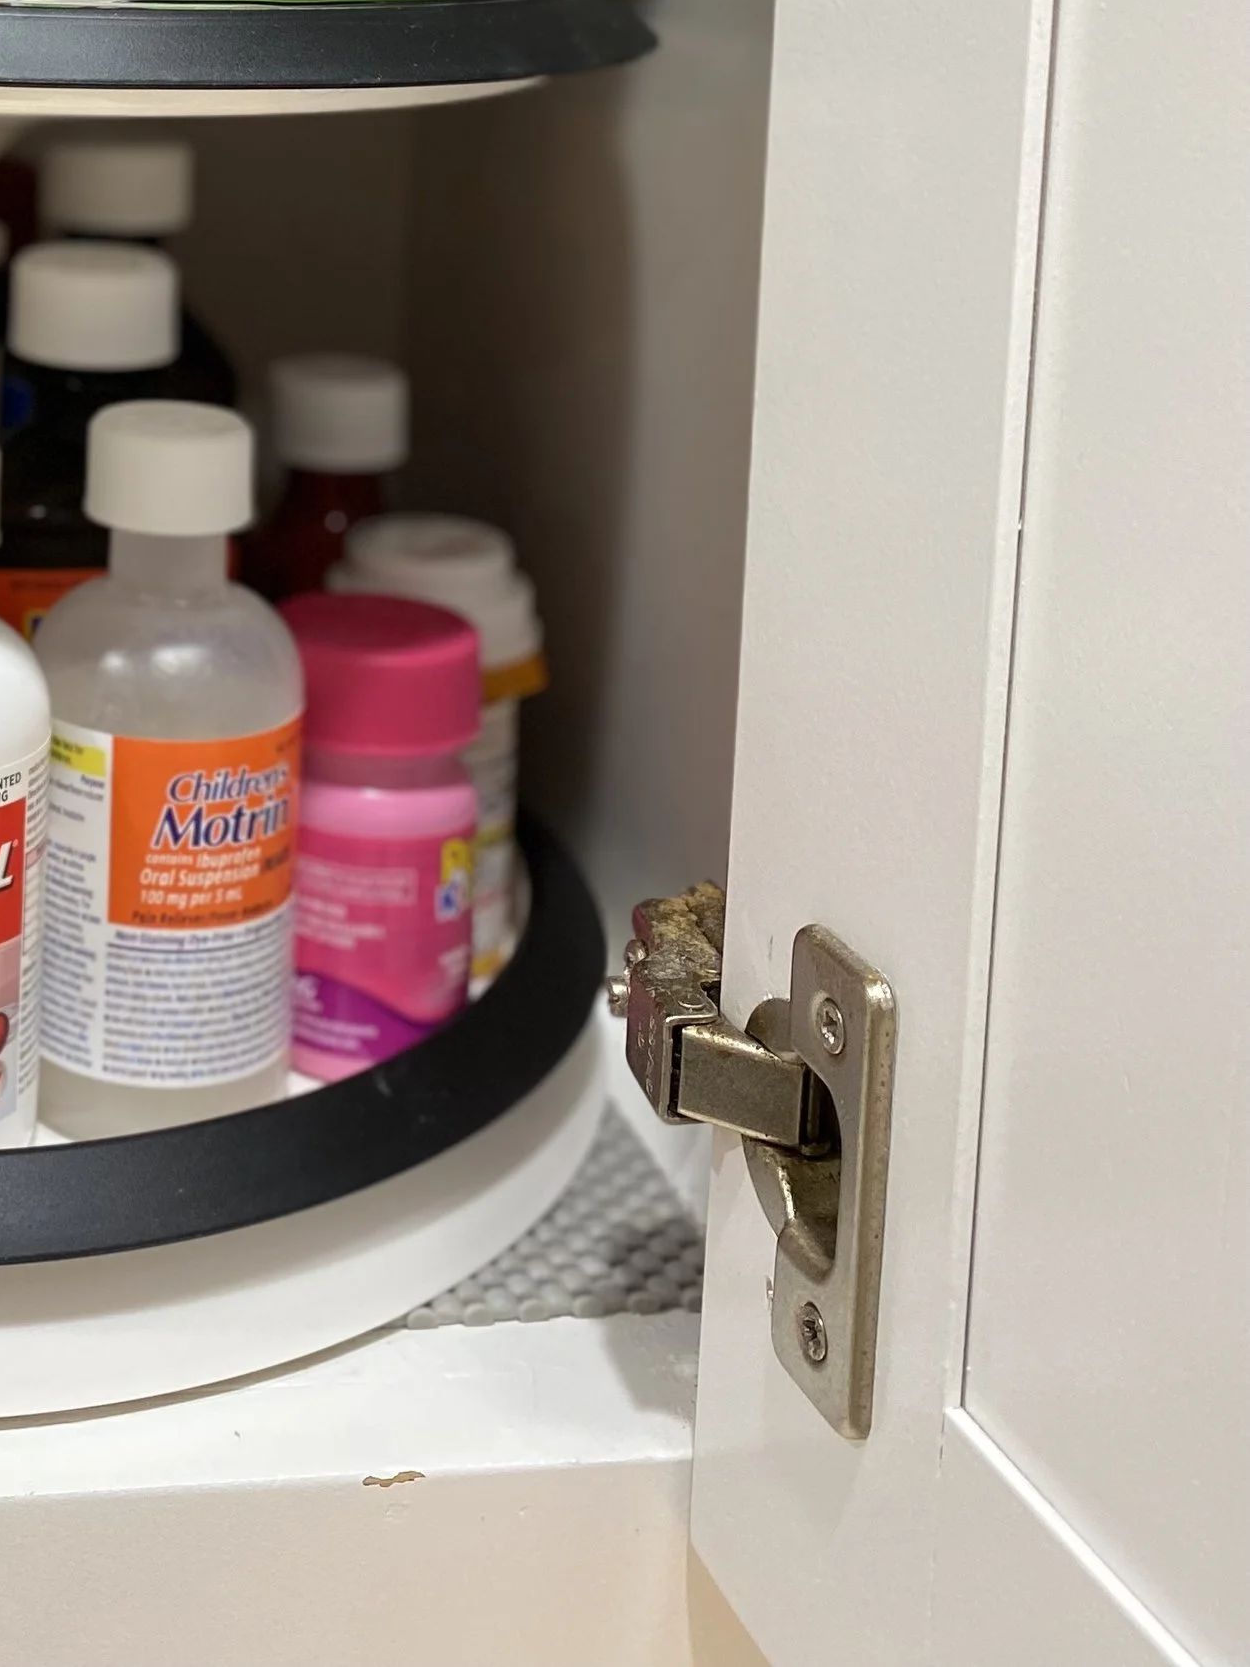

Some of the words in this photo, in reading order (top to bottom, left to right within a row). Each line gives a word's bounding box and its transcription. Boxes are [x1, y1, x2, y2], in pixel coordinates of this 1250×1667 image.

[153, 794, 288, 847] Motrin
[140, 868, 174, 886] Oral
[178, 864, 261, 890] Suspension
[167, 892, 188, 910] mg
